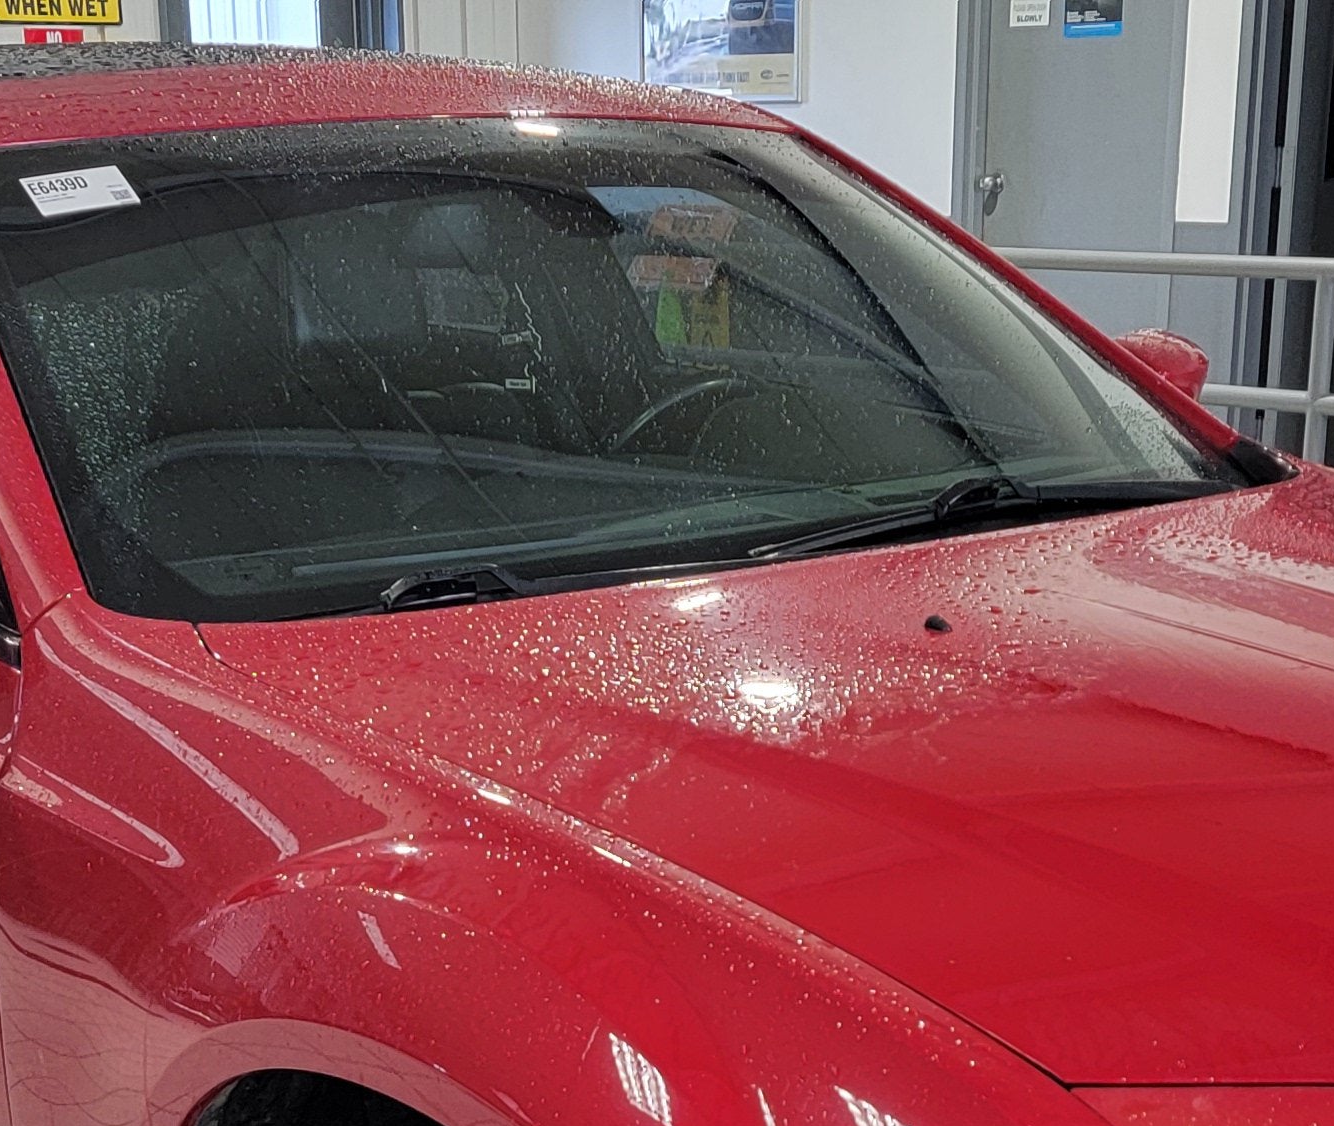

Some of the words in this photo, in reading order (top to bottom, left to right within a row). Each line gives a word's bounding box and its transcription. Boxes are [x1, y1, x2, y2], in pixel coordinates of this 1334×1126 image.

[4, 0, 62, 16] WHEN
[68, 0, 109, 17] WET
[46, 31, 62, 44] NO
[27, 175, 89, 196] E6439D
